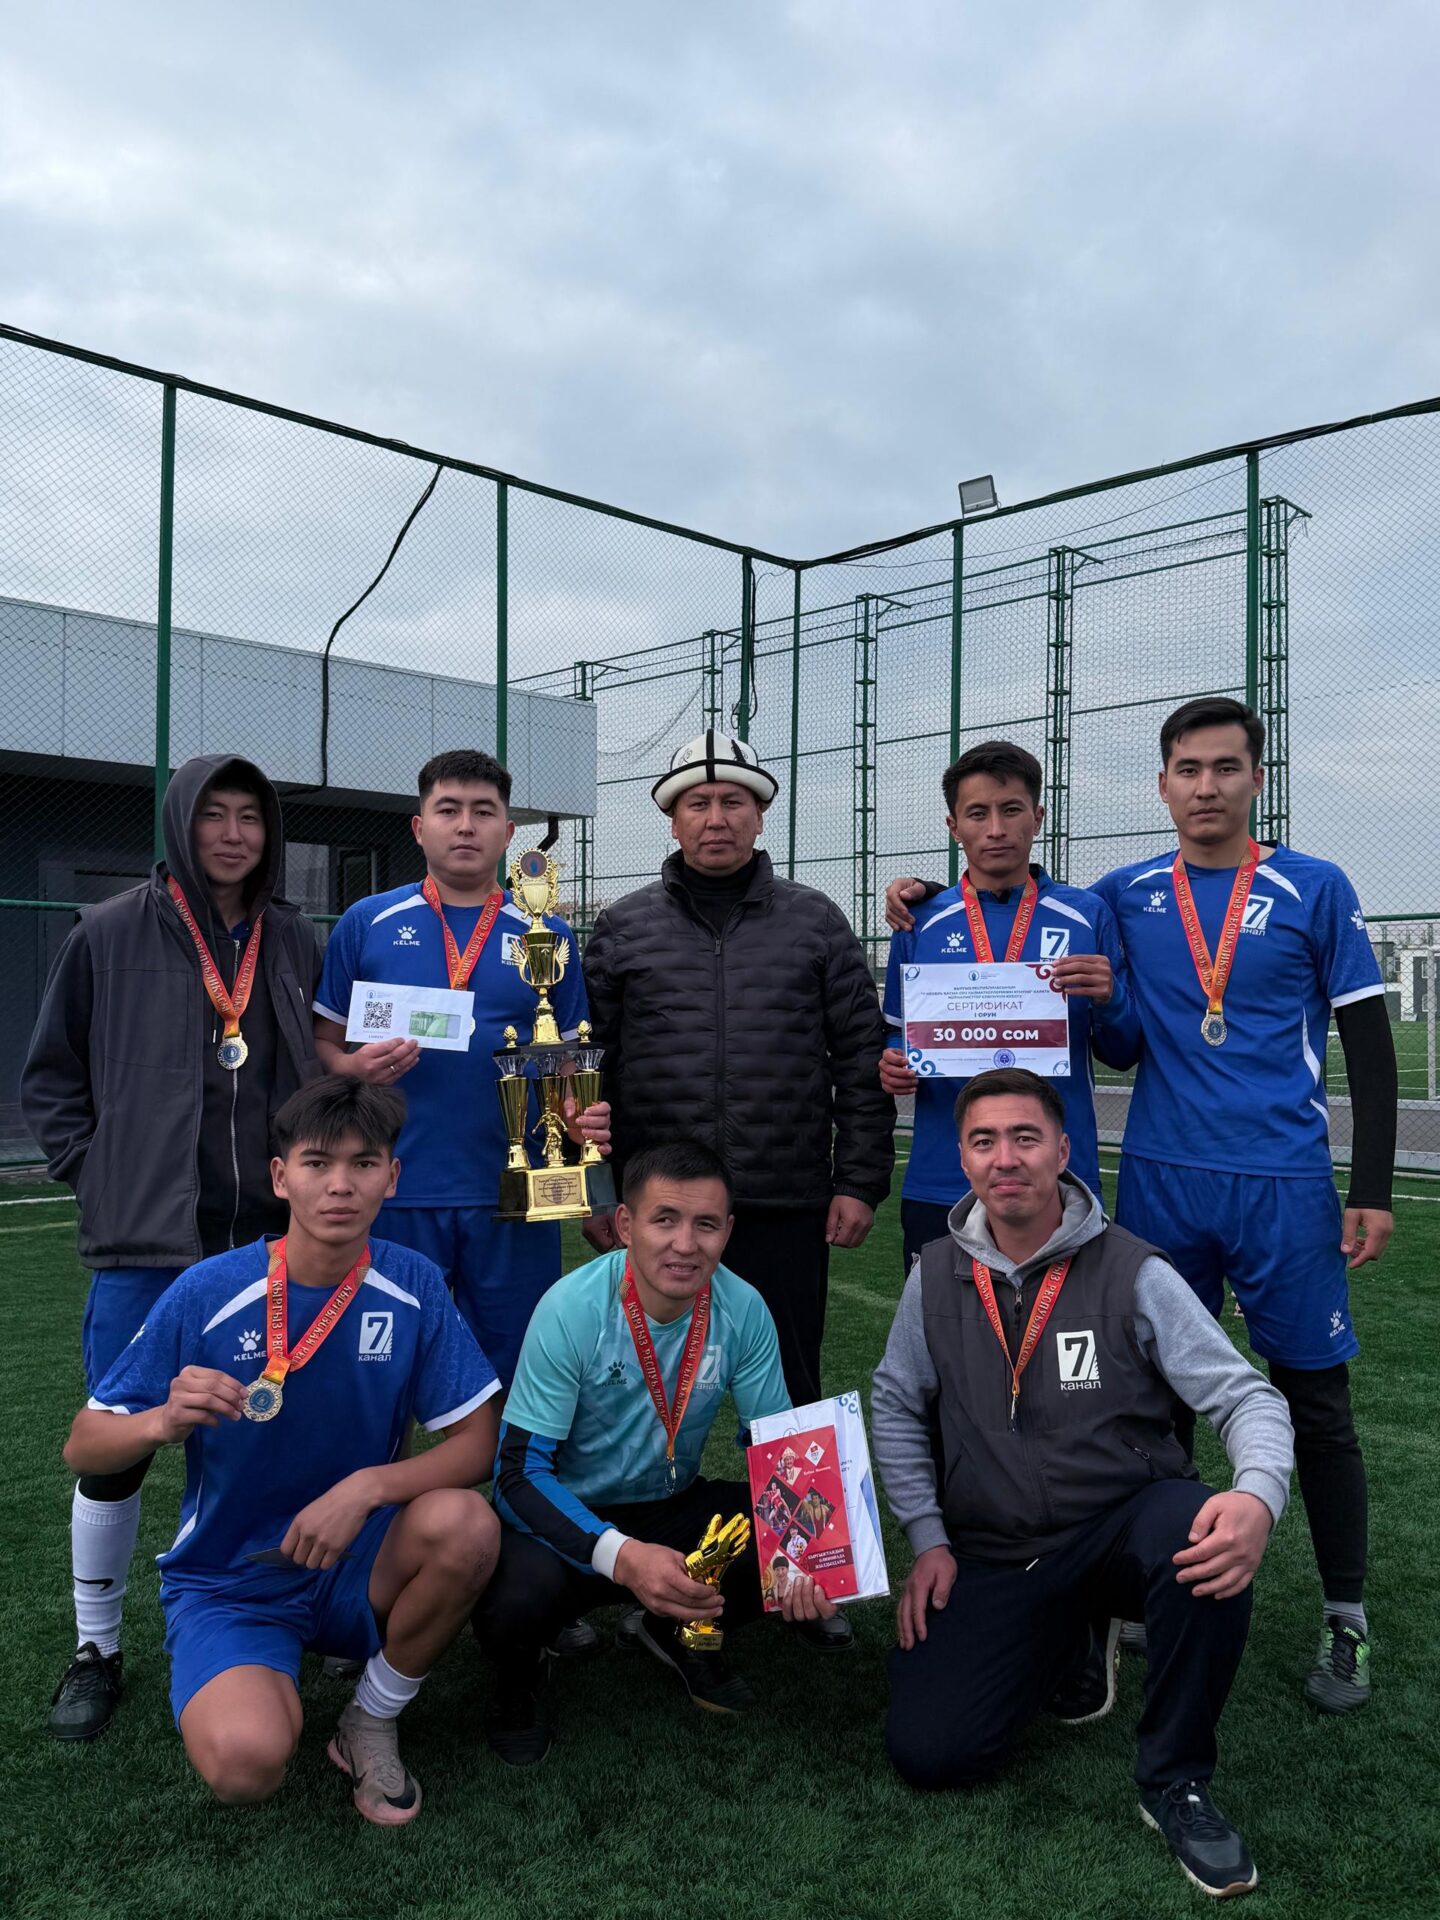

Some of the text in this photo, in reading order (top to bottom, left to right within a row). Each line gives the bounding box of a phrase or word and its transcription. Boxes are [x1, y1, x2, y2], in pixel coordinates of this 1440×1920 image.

[1239, 926, 1265, 936] анал
[1046, 931, 1065, 956] 7
[947, 1001, 1024, 1011] СЕРТИФИКАТ
[933, 1028, 956, 1041] 30
[961, 1027, 997, 1041] 000
[271, 1279, 283, 1329] КЫРГЫЗ
[304, 1284, 354, 1347] КЫРГЫЗСКАЯ
[627, 1301, 648, 1346] КЫРГЫЗ
[367, 1316, 388, 1350] 7
[234, 1351, 267, 1362] KELME
[358, 1354, 392, 1362] канал
[1064, 1336, 1088, 1376] 7
[1060, 1380, 1102, 1391] канал
